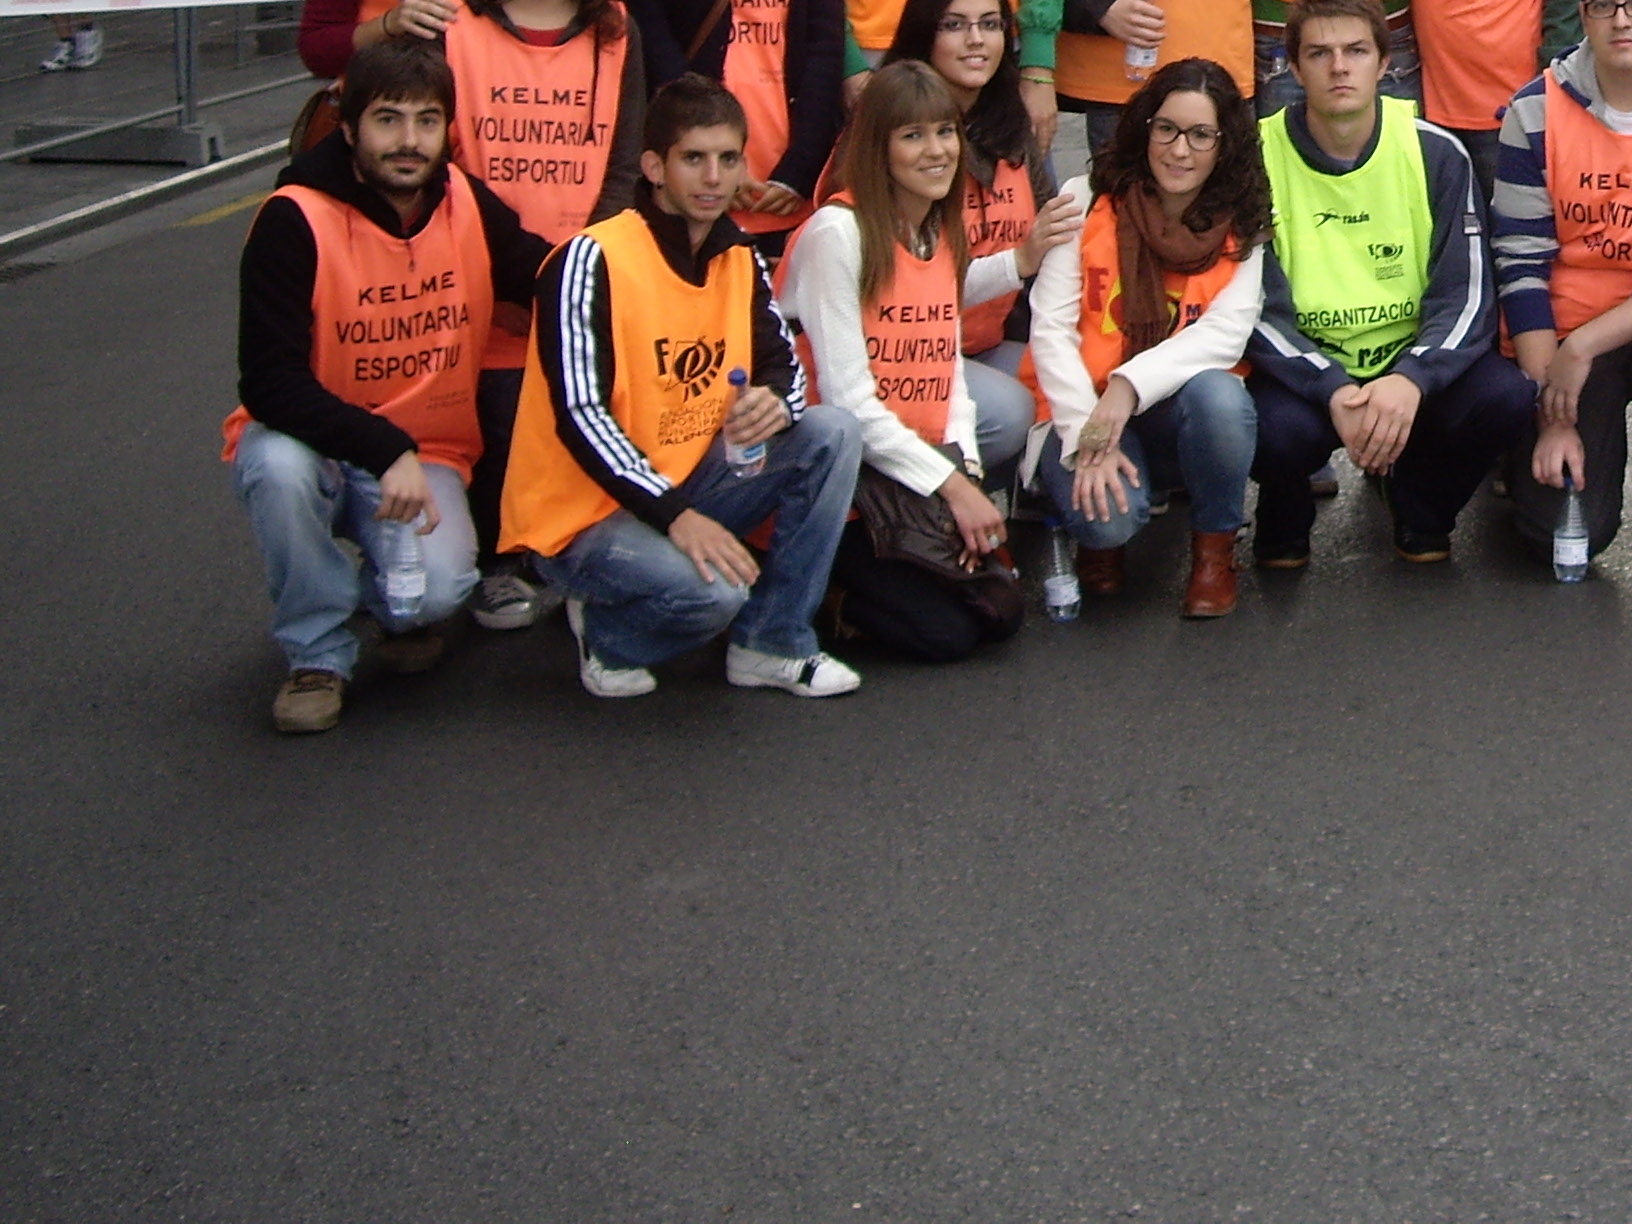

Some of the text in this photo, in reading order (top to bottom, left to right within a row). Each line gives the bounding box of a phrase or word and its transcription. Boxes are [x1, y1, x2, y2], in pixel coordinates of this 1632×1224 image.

[728, 21, 781, 45] ORTIU
[490, 86, 588, 106] KELME
[471, 116, 608, 147] VOLUNTARIAT
[488, 156, 587, 184] ESPORTIU
[967, 188, 1014, 209] ELME
[358, 271, 455, 306] KELME
[335, 303, 469, 344] VOLUNTARIA
[878, 303, 954, 323] KELME
[1296, 297, 1415, 327] ORGANITZACIÓ
[355, 344, 461, 381] ESPORTIU
[866, 337, 957, 363] OLUNTARIA
[874, 376, 951, 402] SPORTIU
[659, 427, 714, 446] VALENC
